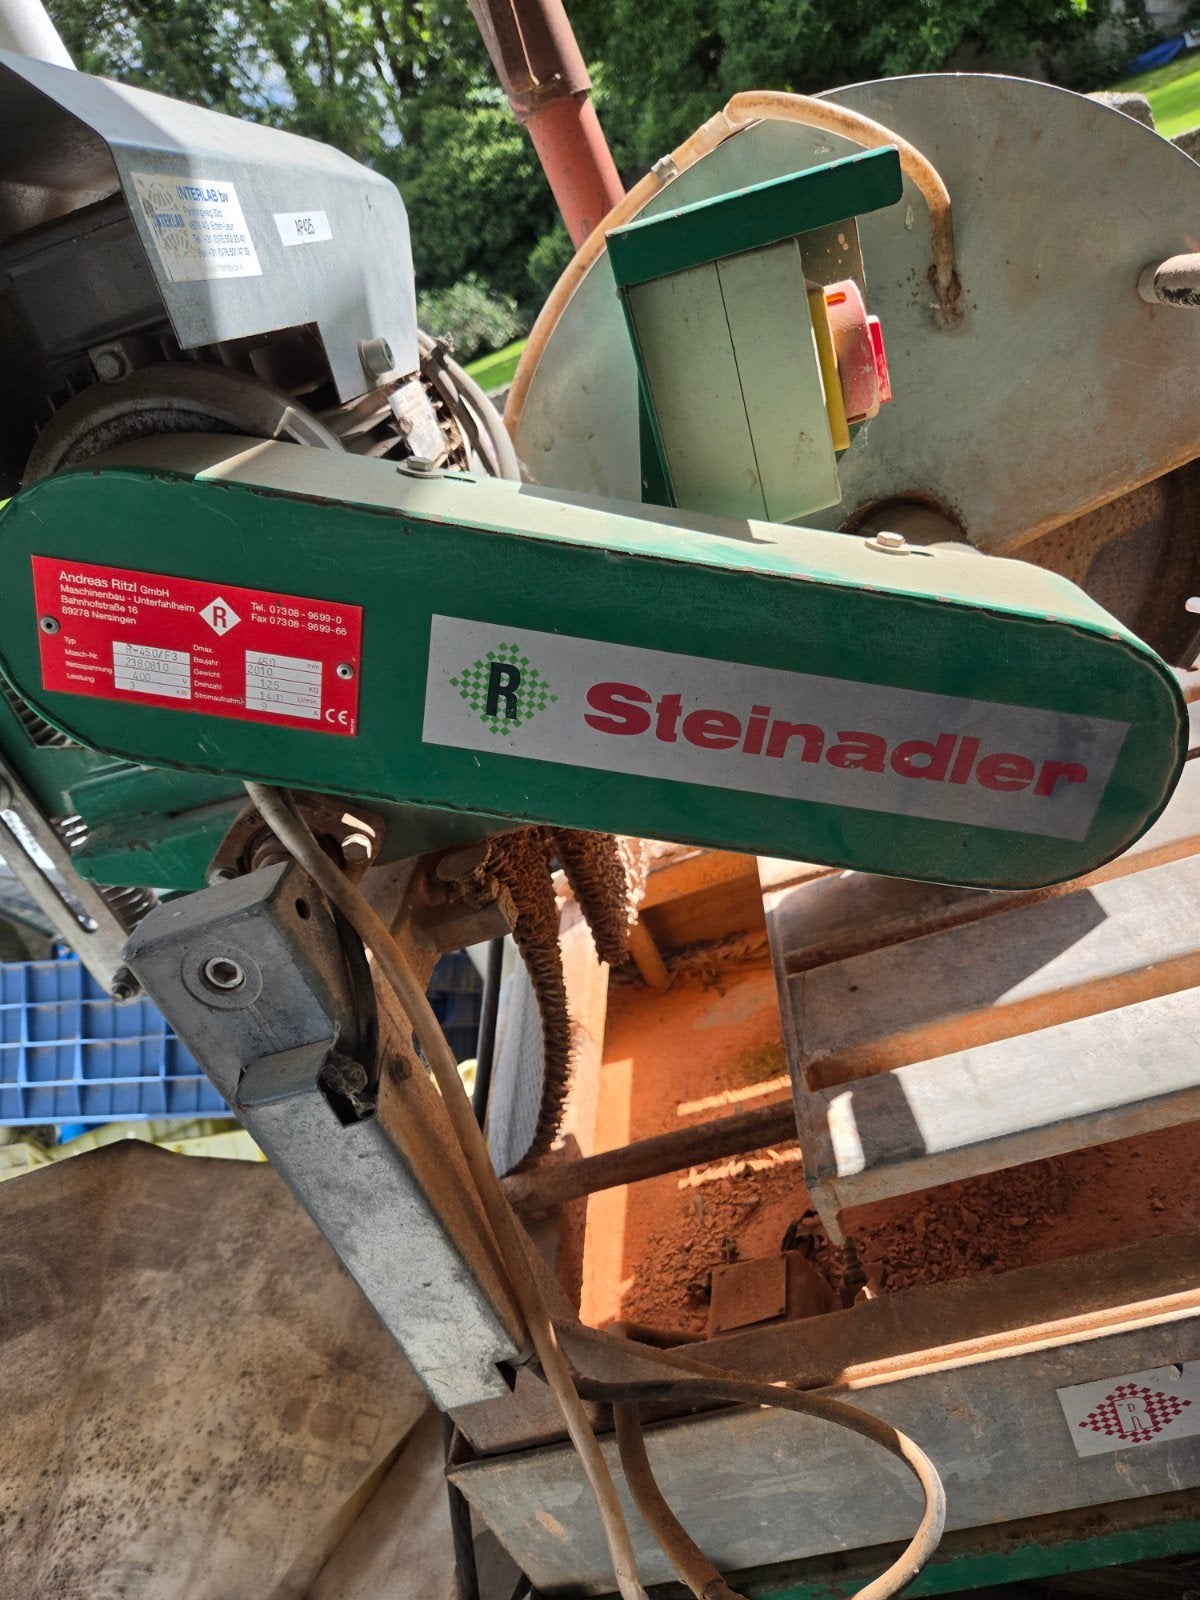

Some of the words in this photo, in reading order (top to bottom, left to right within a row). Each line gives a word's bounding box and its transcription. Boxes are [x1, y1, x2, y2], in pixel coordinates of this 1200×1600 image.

[176, 186, 218, 202] INTERLAB
[218, 189, 229, 204] bv
[59, 571, 108, 588] Andreas
[111, 578, 137, 592] Ritzl
[140, 586, 170, 597] GmbH
[60, 584, 125, 602] Maschinenbau
[134, 596, 195, 612] Unterfahlheim
[61, 595, 126, 612] Bahnhofstraße
[128, 606, 138, 614] 16
[251, 602, 266, 612] Tel.
[62, 606, 89, 618] 89278
[92, 611, 136, 625] Nersingen
[212, 606, 227, 628] R
[251, 614, 267, 624] Fax
[64, 636, 76, 646] Typ
[126, 657, 168, 672] 2380810
[193, 656, 219, 666] Baujahr
[248, 664, 273, 676] 2010
[257, 657, 276, 666] 450
[67, 672, 95, 684] Leistung
[129, 681, 135, 690] 3
[133, 672, 151, 681] 400
[193, 668, 220, 678] Gewicht
[260, 679, 279, 690] 125
[194, 680, 222, 690] Drehzahl
[260, 692, 283, 702] 1400
[486, 661, 522, 720] R
[261, 702, 267, 710] 9
[325, 708, 348, 725] CE
[583, 681, 1089, 797] Steinadler
